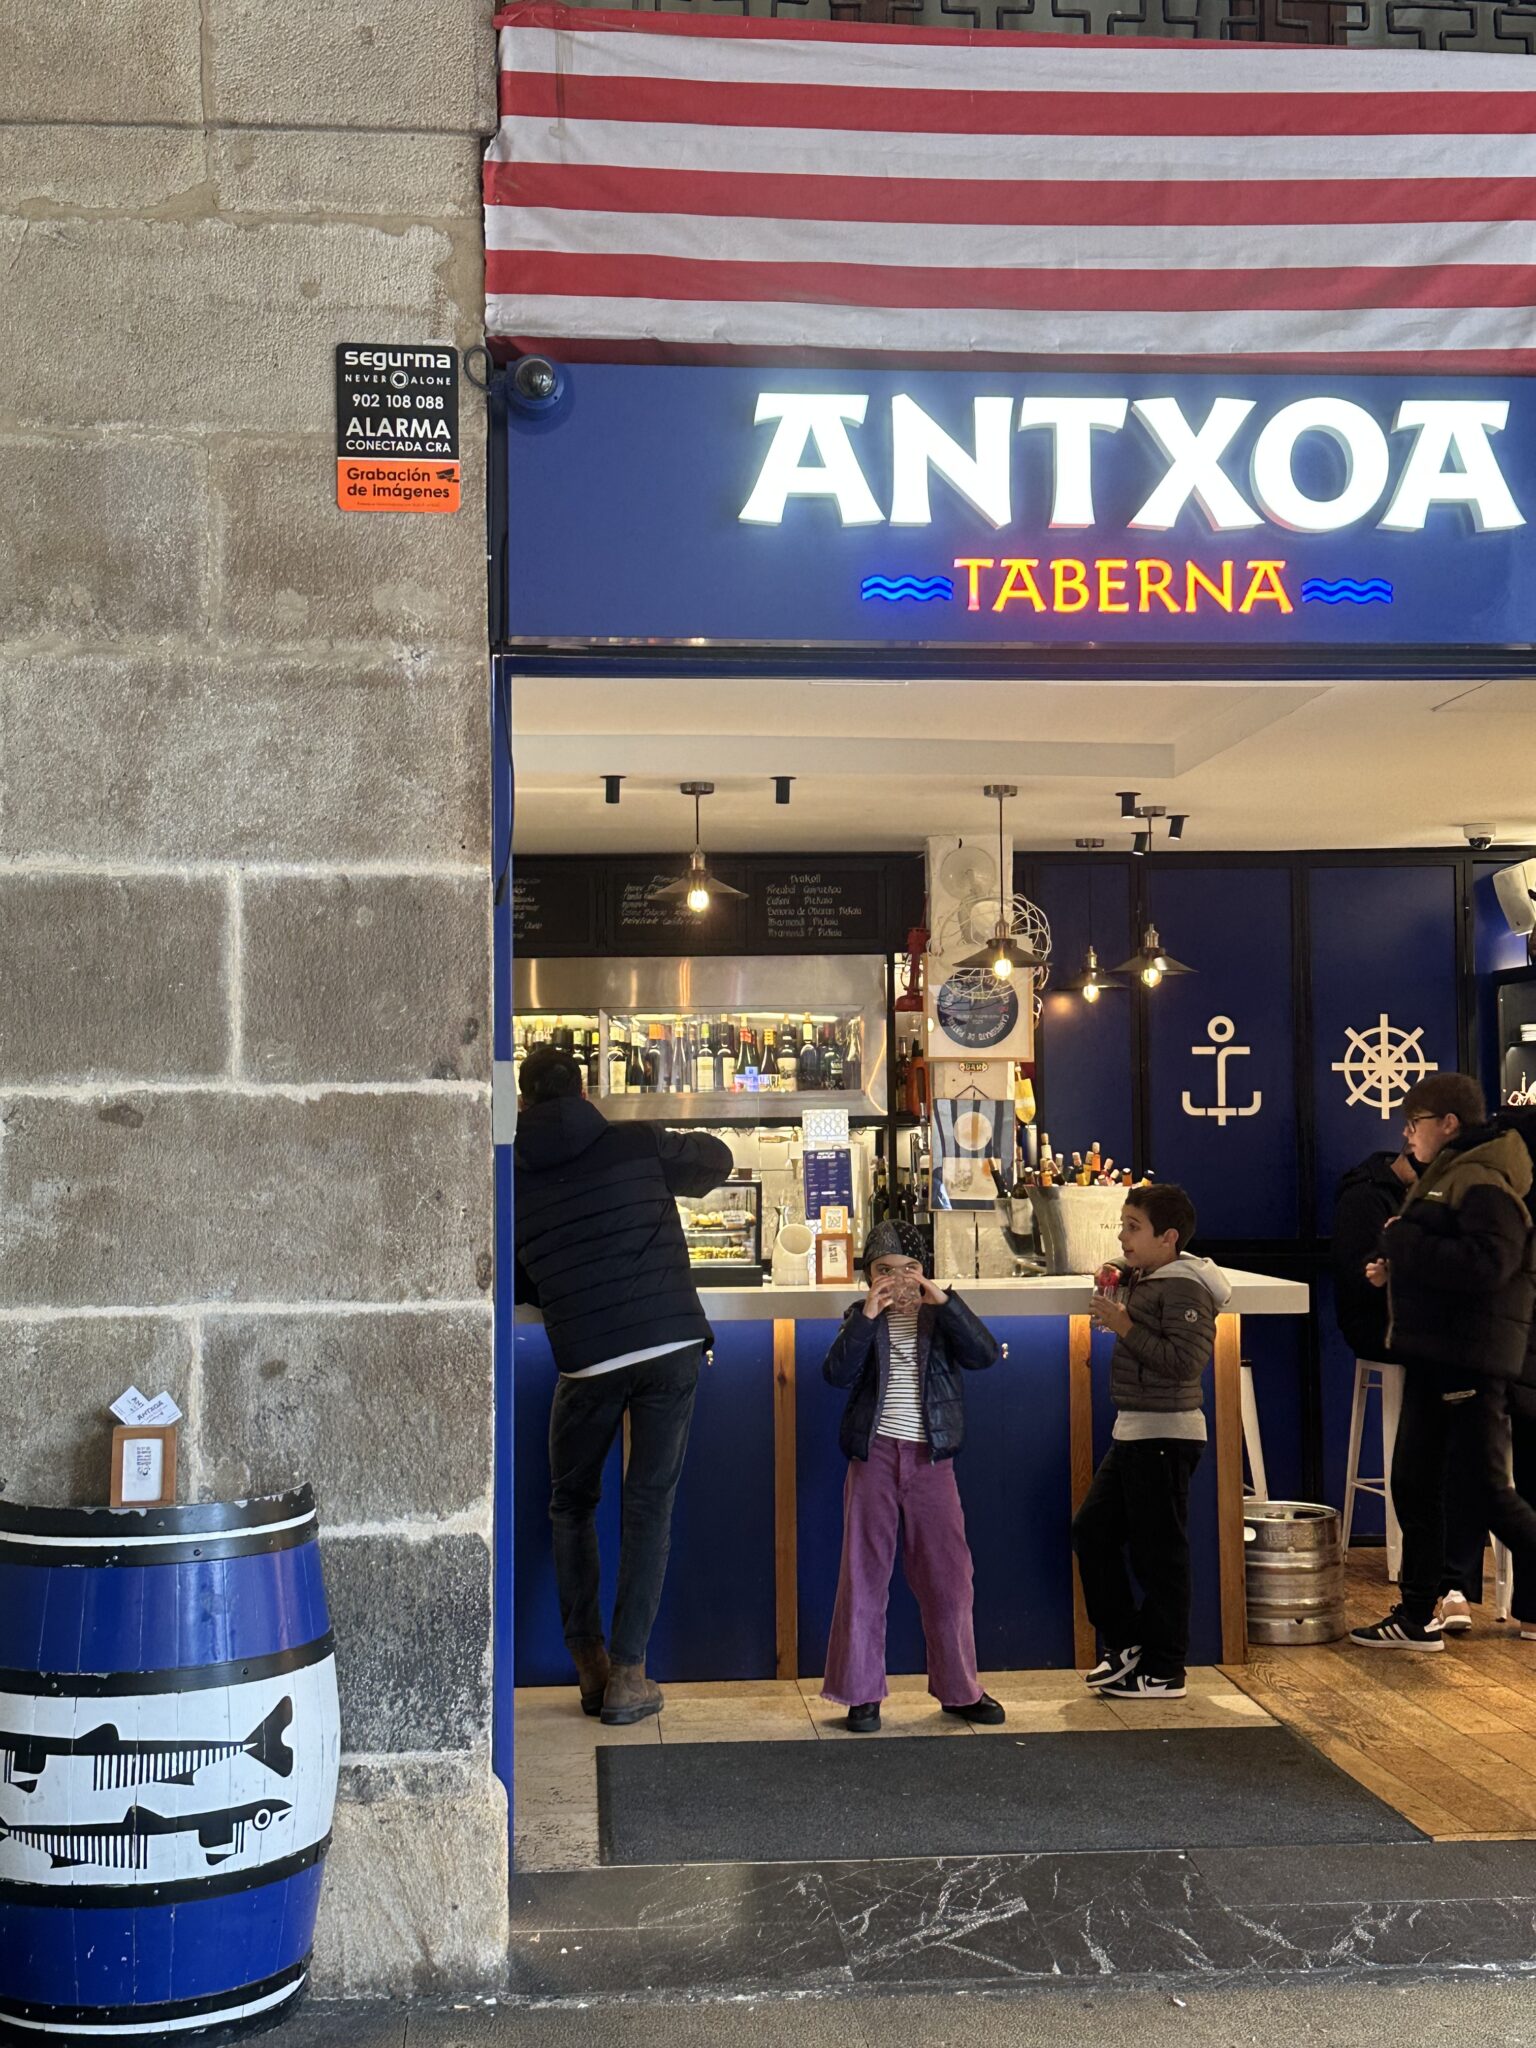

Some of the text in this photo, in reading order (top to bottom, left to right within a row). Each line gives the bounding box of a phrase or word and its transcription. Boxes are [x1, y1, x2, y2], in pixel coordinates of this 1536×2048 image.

[344, 350, 451, 371] segurma
[345, 373, 451, 386] NEVER ALONE
[352, 393, 445, 410] 902 108 088
[345, 416, 451, 439] ALARMA
[345, 439, 452, 453] CONECTADA CRA
[738, 393, 1527, 533] ANTXOA
[346, 467, 431, 482] Grabación
[346, 482, 450, 500] de imágenes
[953, 558, 1294, 614] TABERNA
